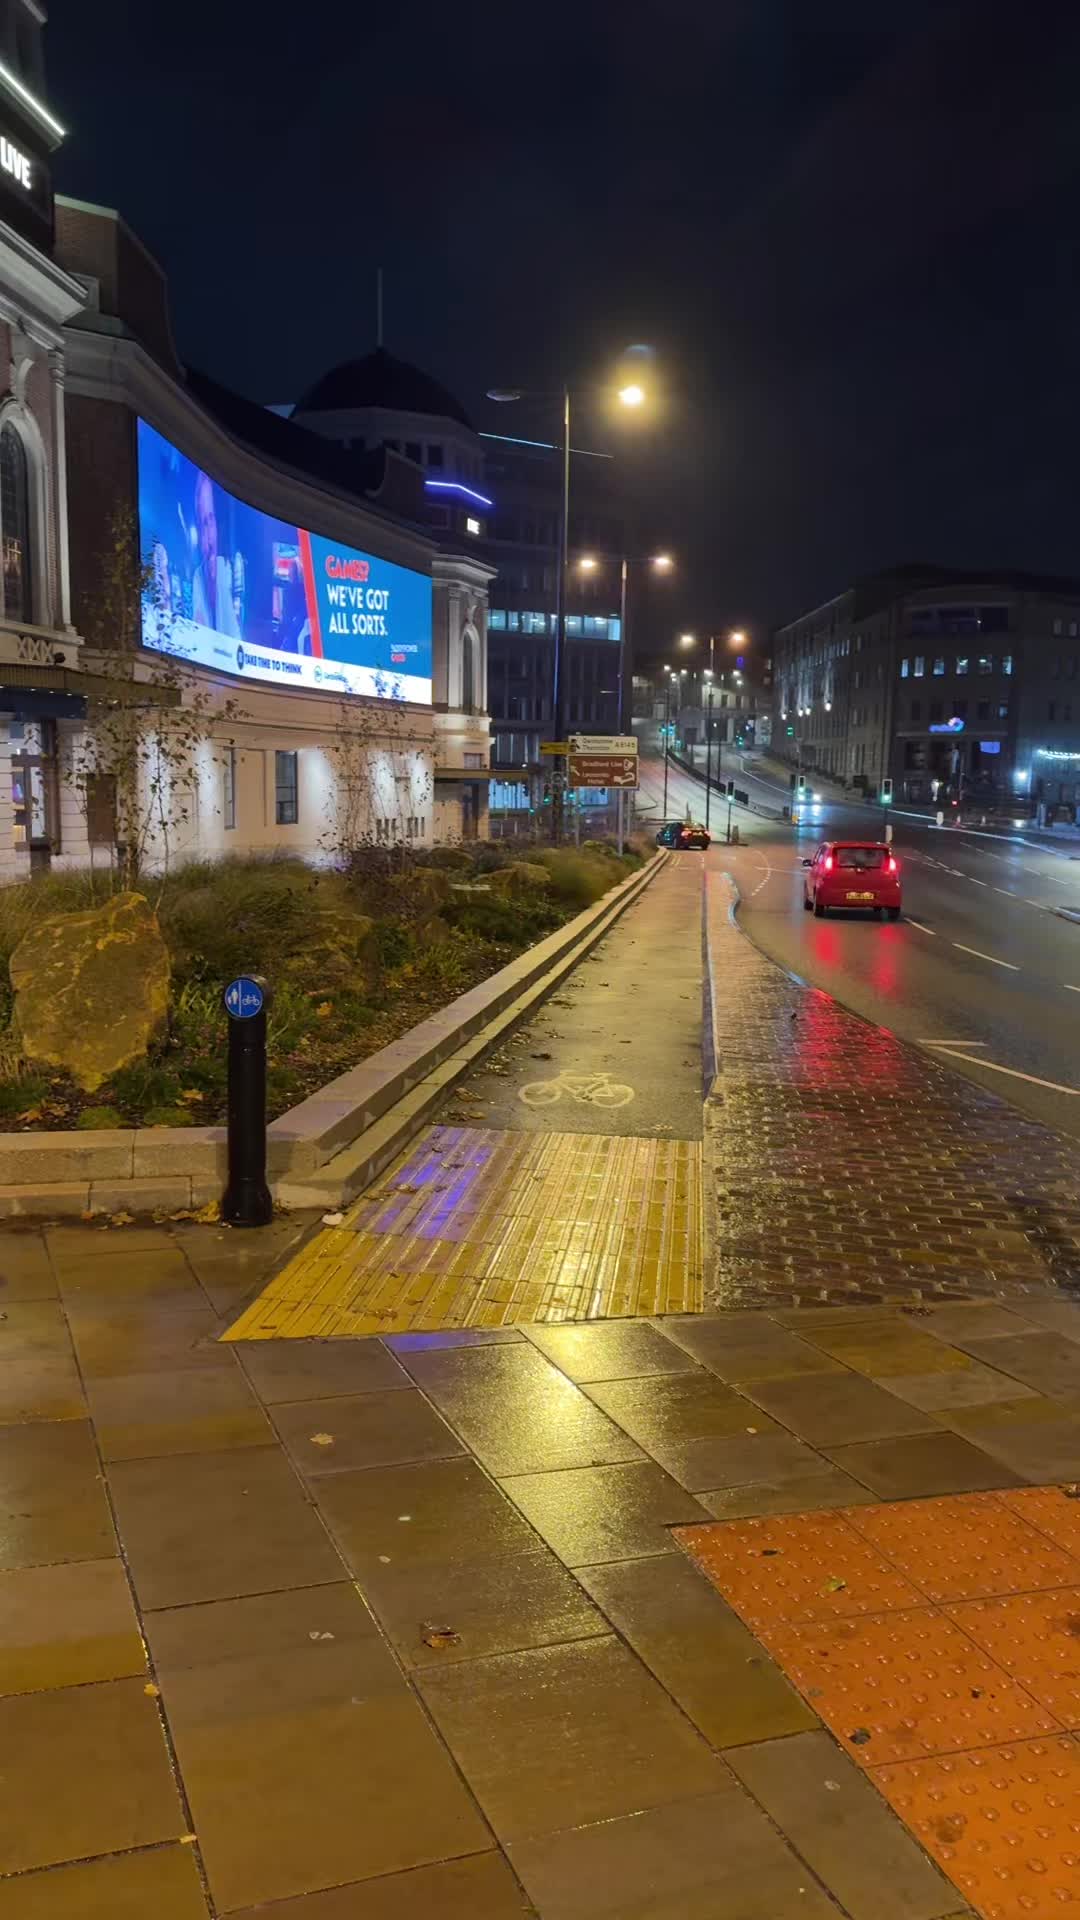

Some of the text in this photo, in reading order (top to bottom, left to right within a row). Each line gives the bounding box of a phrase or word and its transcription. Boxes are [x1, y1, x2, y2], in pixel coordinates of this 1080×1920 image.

[0, 136, 32, 190] LIVE
[326, 584, 389, 611] WE'VE GOT
[329, 611, 389, 636] ALL SORTS.
[244, 653, 257, 667] TAKE
[258, 656, 271, 670] TIME
[271, 659, 281, 671] TO
[282, 662, 303, 675] THINK
